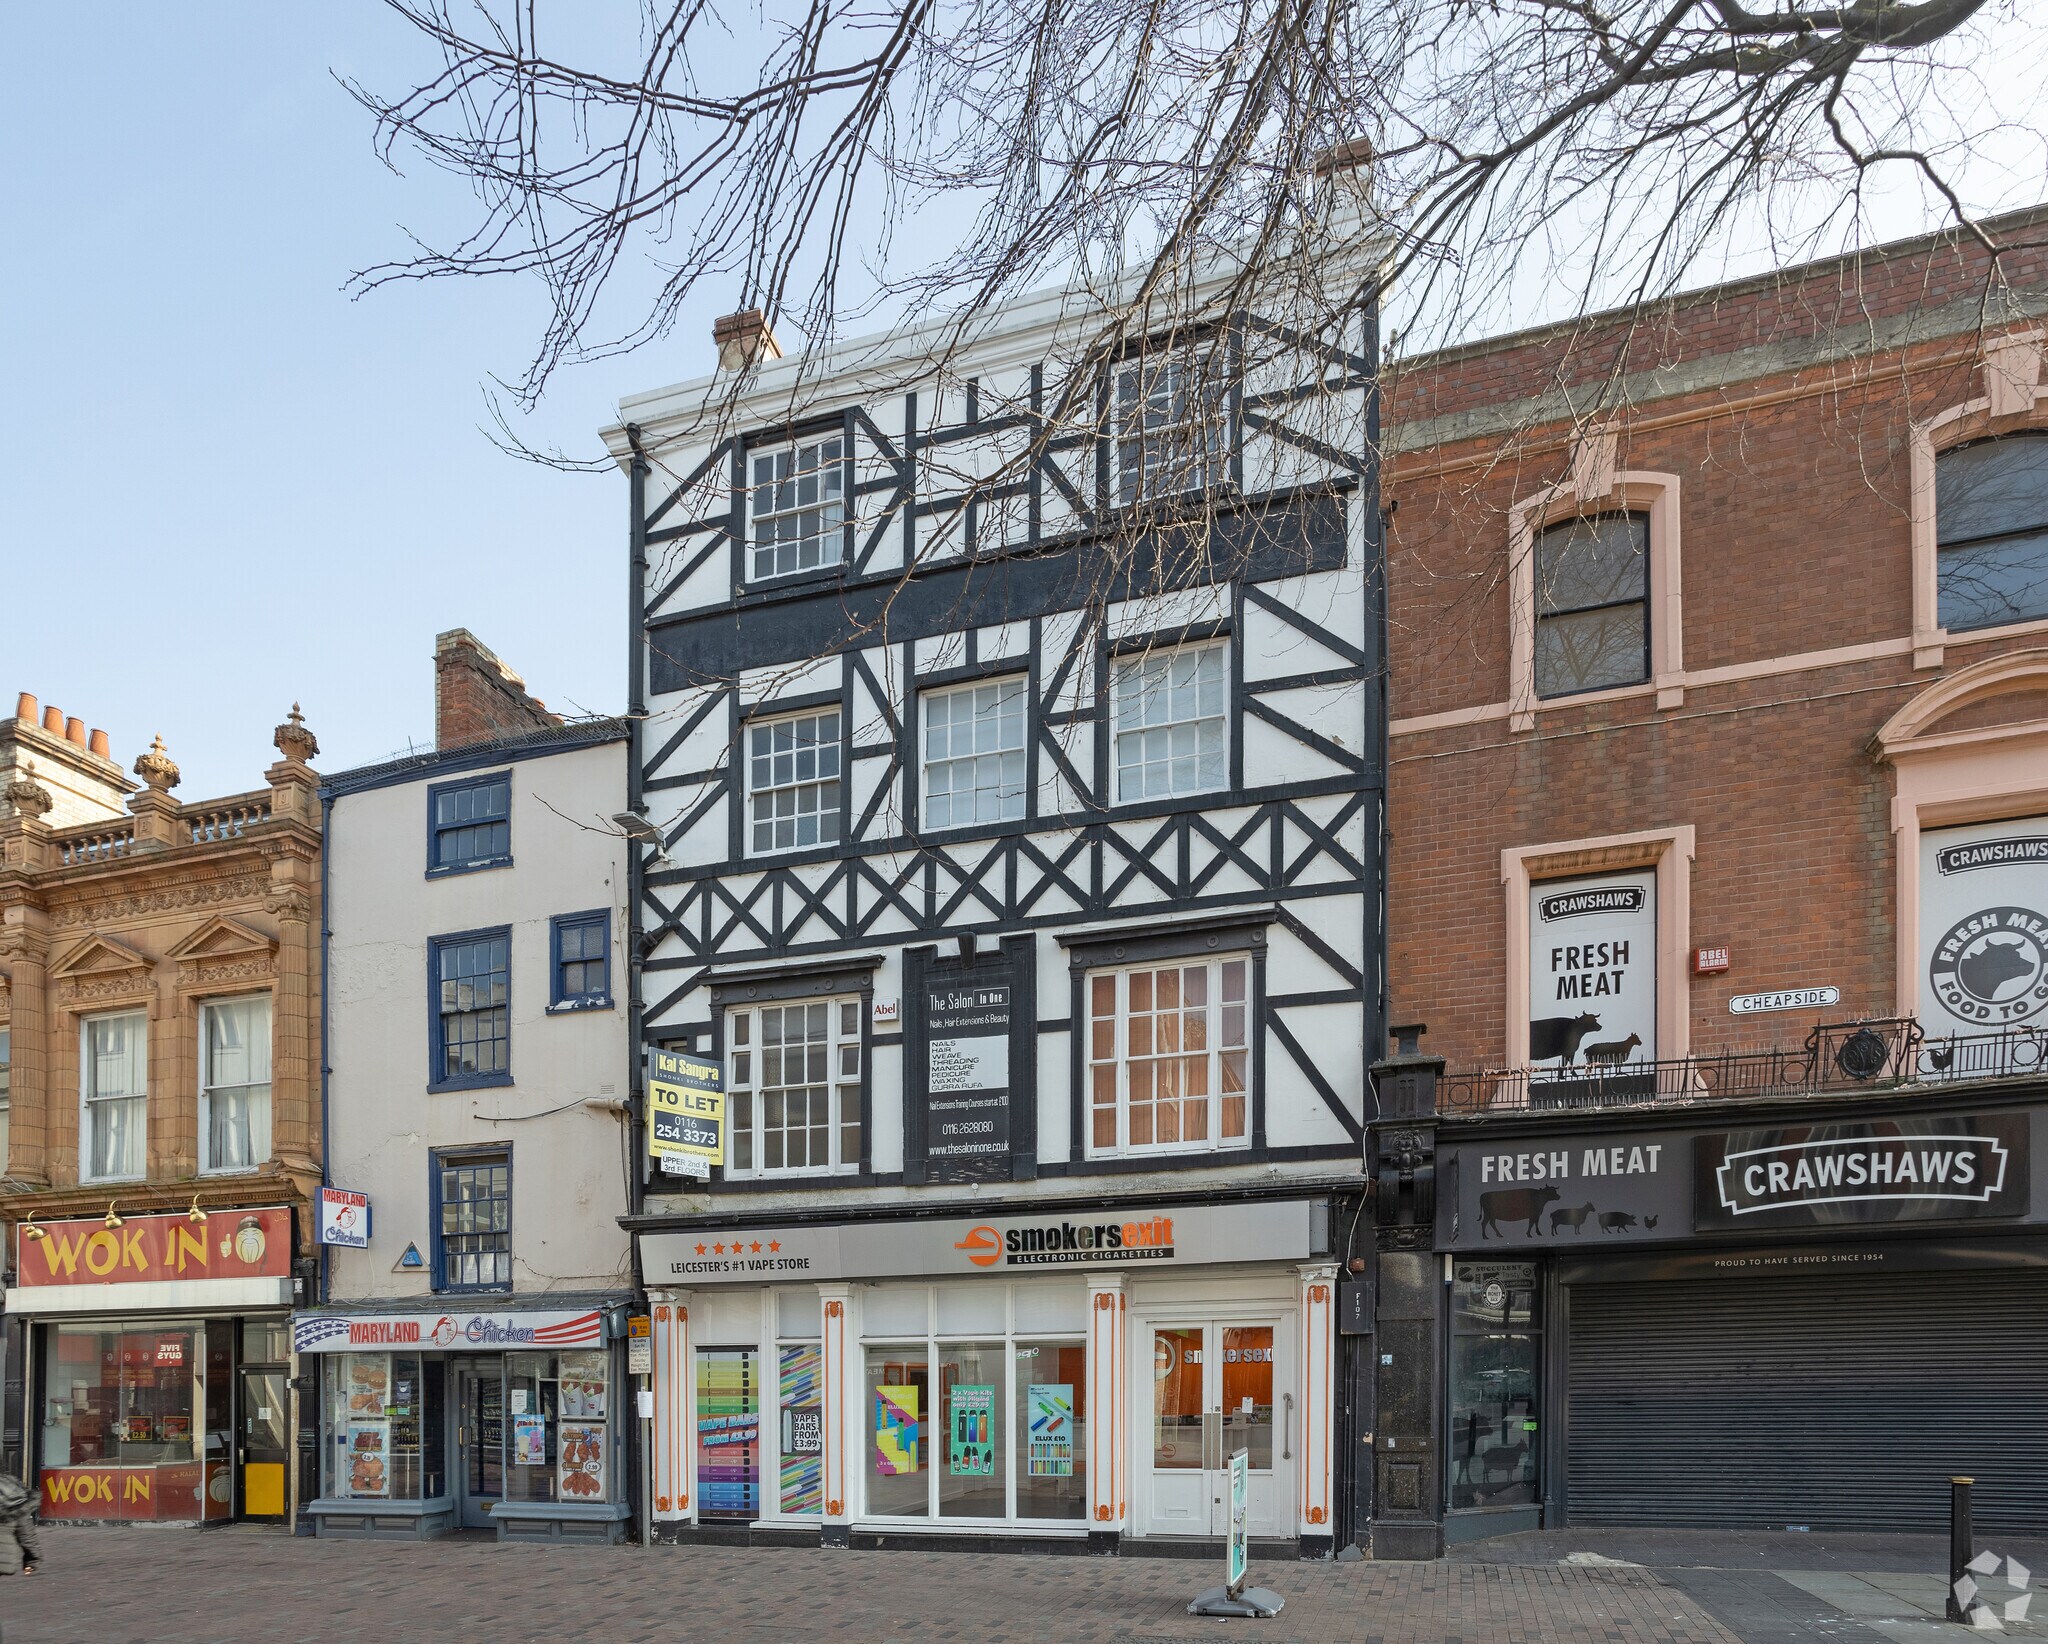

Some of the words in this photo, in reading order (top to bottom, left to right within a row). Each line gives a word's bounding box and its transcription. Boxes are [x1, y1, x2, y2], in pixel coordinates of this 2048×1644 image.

[1949, 842, 2048, 867] CRAWSHAWS
[1550, 892, 1633, 915] CRAWSHAWS
[1938, 913, 1999, 963] FRESH
[2006, 913, 2048, 950] MEA
[1551, 940, 1629, 972] FRESH
[1700, 949, 1727, 960] ABEL
[1700, 958, 1727, 967] ALARM
[1556, 970, 1624, 1000] MEAT
[929, 994, 945, 1011] The
[948, 992, 973, 1010] Salon
[980, 993, 987, 1004] In
[989, 993, 1003, 1004] One
[1742, 990, 1827, 1010] CHEAPSIDE
[1940, 981, 1990, 1019] FOOD
[2000, 1001, 2028, 1019] TO
[874, 1004, 895, 1015] Abel
[945, 1017, 956, 1027] Hair
[956, 1016, 984, 1026] Extensions
[985, 1014, 989, 1024] &
[990, 1013, 1009, 1024] Beauty
[932, 1052, 961, 1060] WEAVE
[932, 1057, 979, 1066] THREADING
[659, 1054, 677, 1072] Kal
[679, 1059, 719, 1080] Sangra
[932, 1064, 975, 1072] MANICURE
[932, 1070, 971, 1078] PEDICURE
[686, 1078, 719, 1089] BROTHERS
[655, 1088, 679, 1105] TO
[684, 1094, 719, 1112] LET
[968, 1098, 983, 1108] Courses
[674, 1116, 697, 1129] 0116
[942, 1123, 959, 1135] 0116
[959, 1121, 993, 1133] 2628080
[656, 1124, 680, 1139] 254
[683, 1129, 717, 1145] 3373
[654, 1144, 720, 1158] www.shonkibrothers.com
[929, 1139, 1009, 1156] www.thesaloninone.co.uk
[662, 1156, 685, 1166] UPPER
[687, 1159, 700, 1168] 2nd
[703, 1161, 708, 1169] &
[664, 1163, 675, 1172] 3rd
[677, 1165, 706, 1176] FLOORS
[1481, 1151, 1568, 1183] FRESH
[1582, 1144, 1662, 1177] MEAT
[1744, 1151, 1976, 1196] CRAWSHAWS
[323, 1189, 366, 1208] MARYLAND
[325, 1226, 365, 1245] Chicken
[1006, 1216, 1174, 1252] smokersexit
[40, 1227, 149, 1276] WOK
[164, 1225, 207, 1274] IN
[1017, 1253, 1087, 1263] ELECTRONIC
[1092, 1249, 1164, 1259] CIGARETTES
[671, 1260, 729, 1274] LEICESTER'S
[732, 1260, 745, 1272] #1
[748, 1259, 775, 1271] VAPE
[777, 1258, 810, 1270] STORE
[1715, 1259, 1746, 1267] PROUD
[1831, 1254, 1859, 1262] SINCE
[1863, 1253, 1884, 1261] 1954
[1476, 1264, 1523, 1272] SUCCULENT
[350, 1322, 420, 1344] MARYLAND
[465, 1315, 536, 1343] Chicken
[698, 1416, 727, 1431] VAPE
[728, 1413, 759, 1427] BARS
[794, 1414, 816, 1423] VAPE
[795, 1422, 816, 1431] BARS
[703, 1433, 729, 1445] FROM
[795, 1431, 819, 1439] FROM
[795, 1439, 817, 1448] £3.99
[46, 1475, 114, 1503] WOK
[123, 1475, 149, 1504] IN
